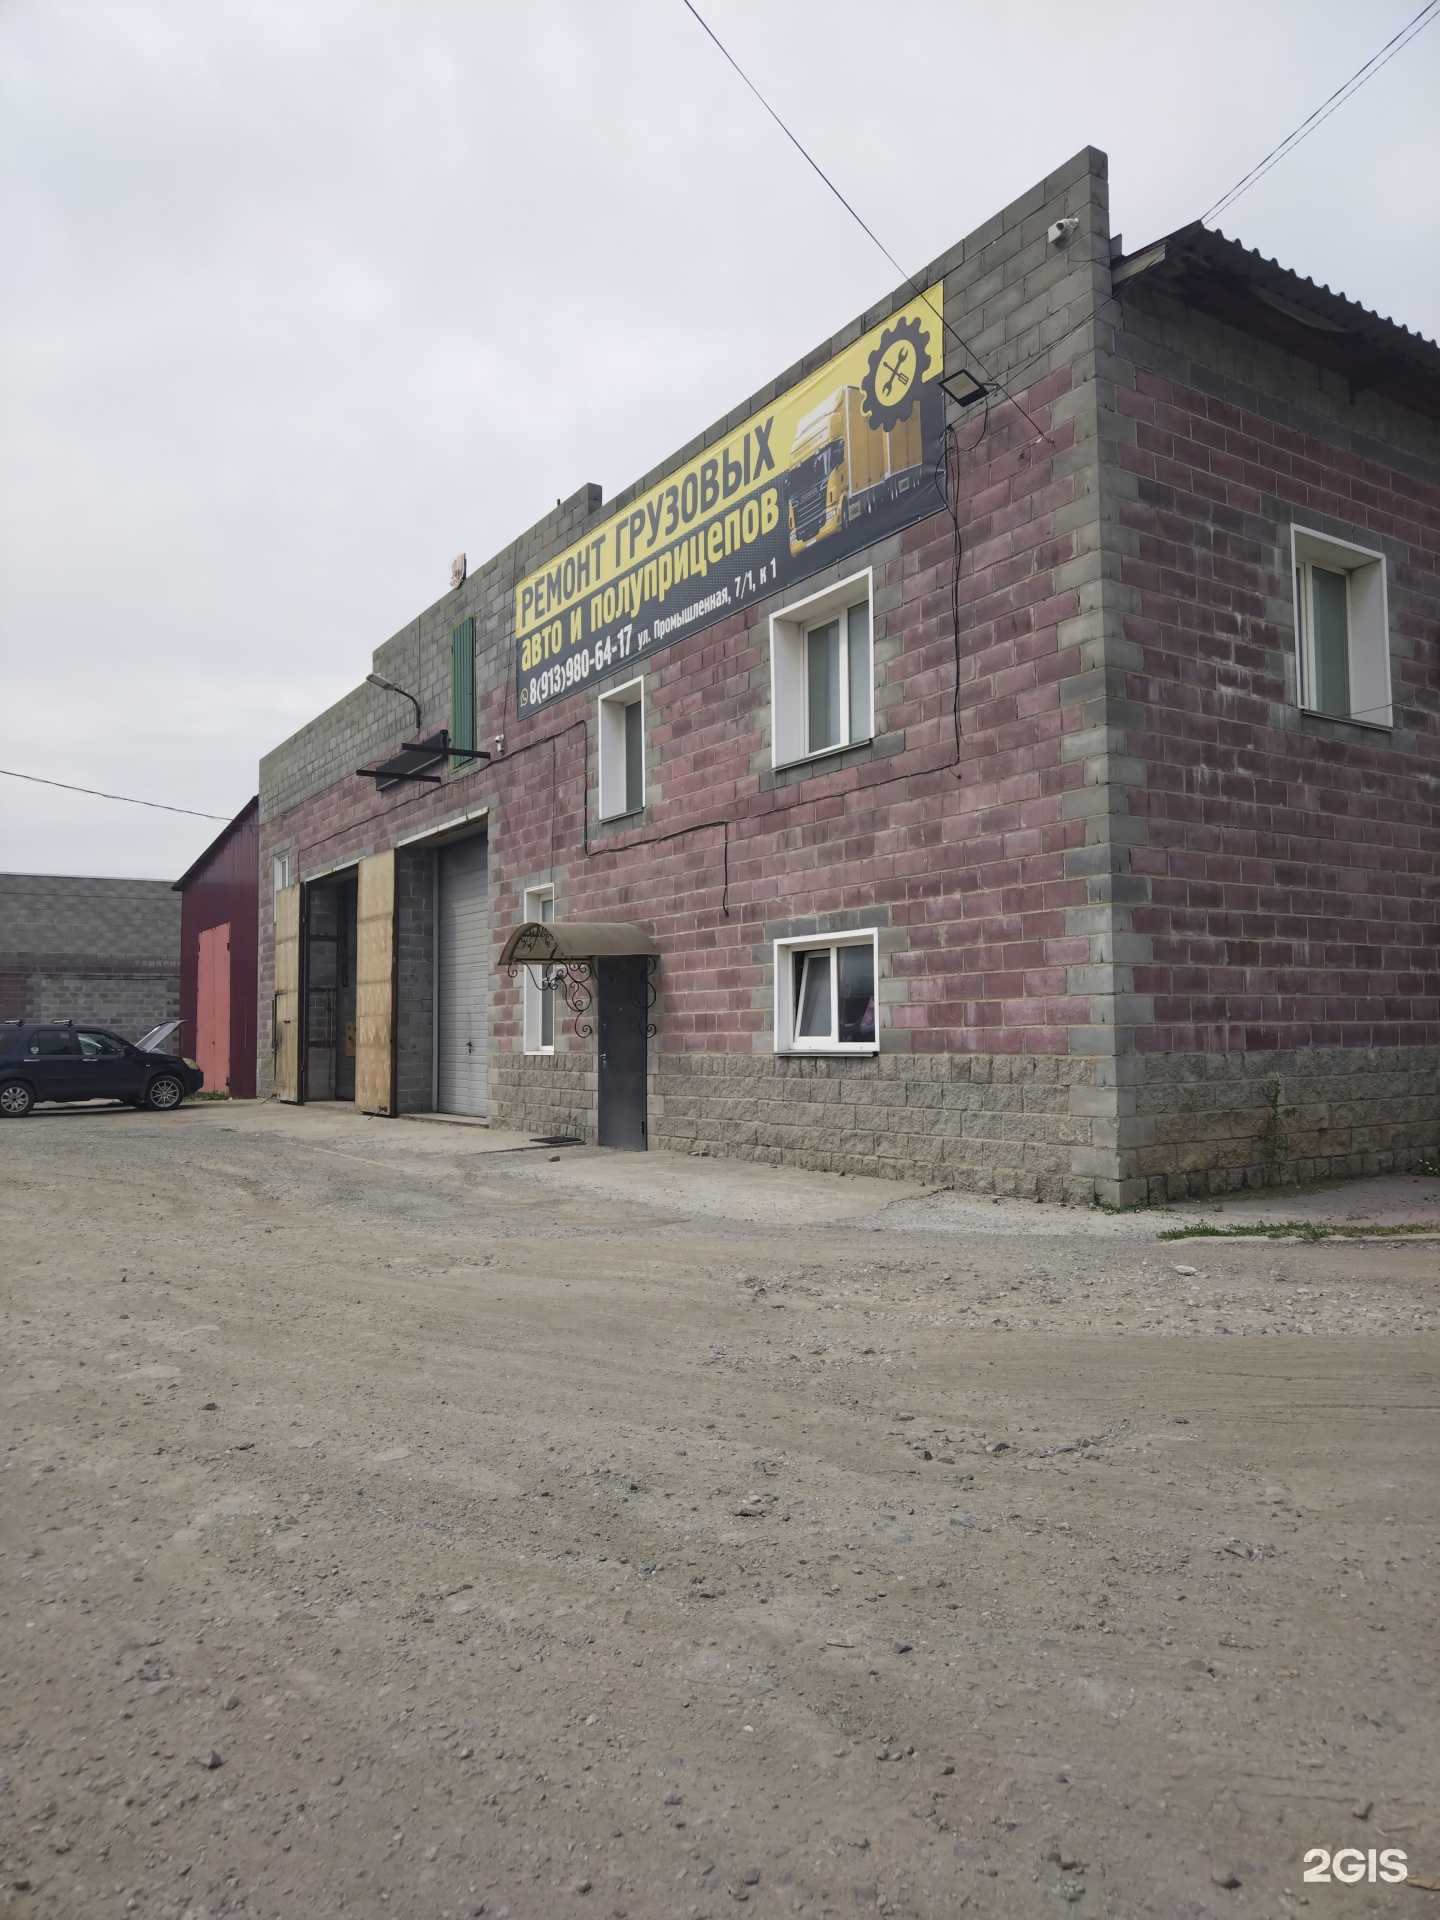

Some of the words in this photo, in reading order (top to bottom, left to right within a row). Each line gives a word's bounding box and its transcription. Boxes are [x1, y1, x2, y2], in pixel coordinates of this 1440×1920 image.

[521, 534, 606, 628] РЕМОНТ
[615, 416, 775, 568] ГРУЗОВЫХ
[521, 619, 563, 671] авто
[570, 606, 582, 644] и
[590, 487, 779, 632] полуприцепов
[529, 623, 633, 705] 8(913)980-64-17
[637, 630, 651, 651] ул.
[654, 587, 732, 640] Промышленная,
[734, 570, 756, 599] 7/1,
[759, 566, 768, 585] к
[770, 556, 777, 579] 1
